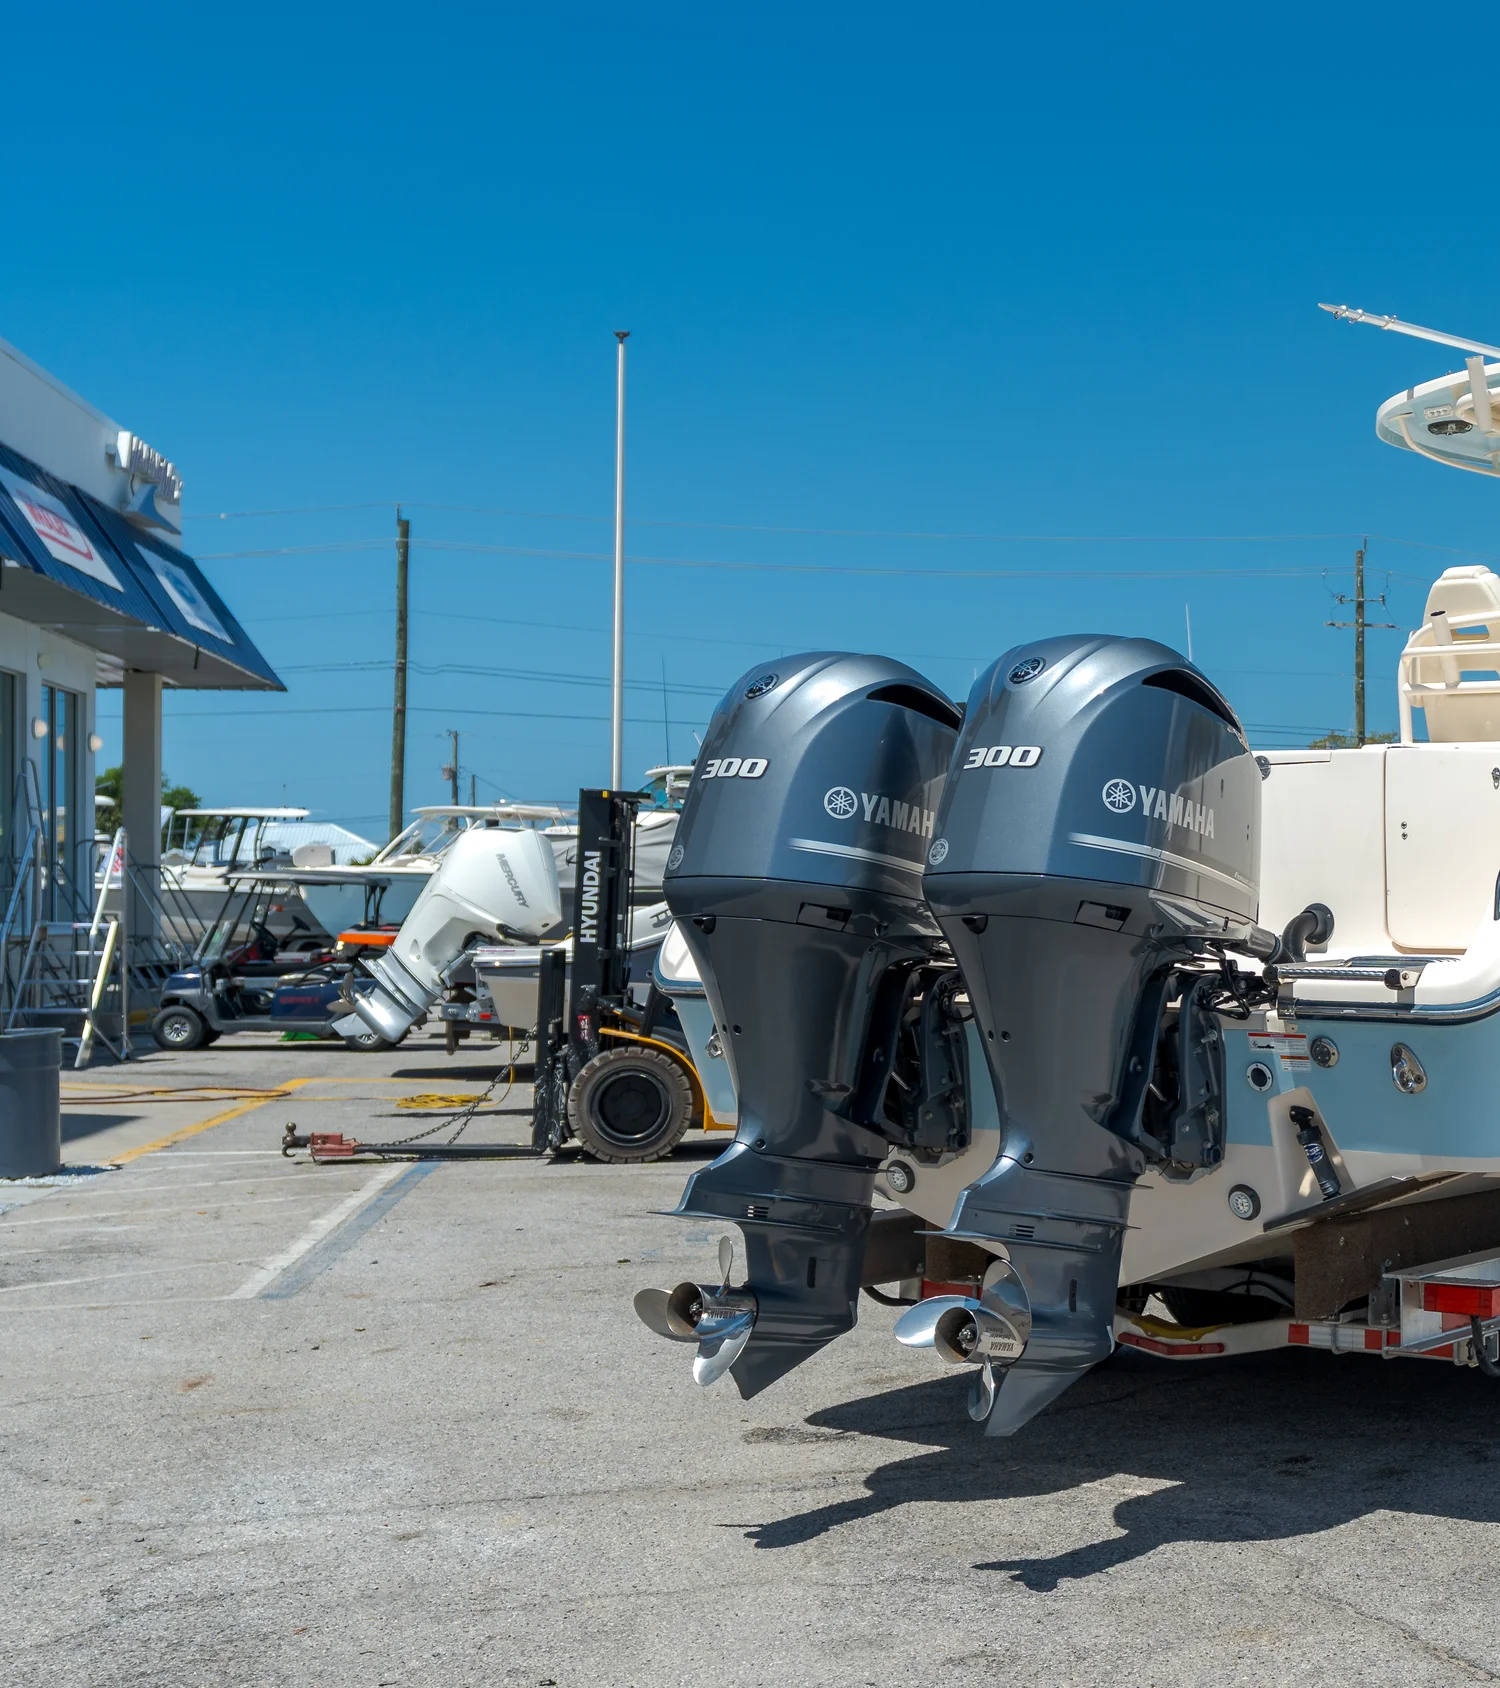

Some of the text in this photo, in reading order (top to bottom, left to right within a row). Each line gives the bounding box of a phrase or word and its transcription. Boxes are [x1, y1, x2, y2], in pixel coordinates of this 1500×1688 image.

[701, 758, 769, 780] 300
[963, 745, 1042, 770] 300
[860, 792, 935, 839] YAMAH
[1138, 785, 1215, 839] YAMAHA
[496, 853, 530, 909] MERCURY
[580, 851, 601, 944] HYUNDAI
[989, 1341, 1015, 1352] YAMAHA
